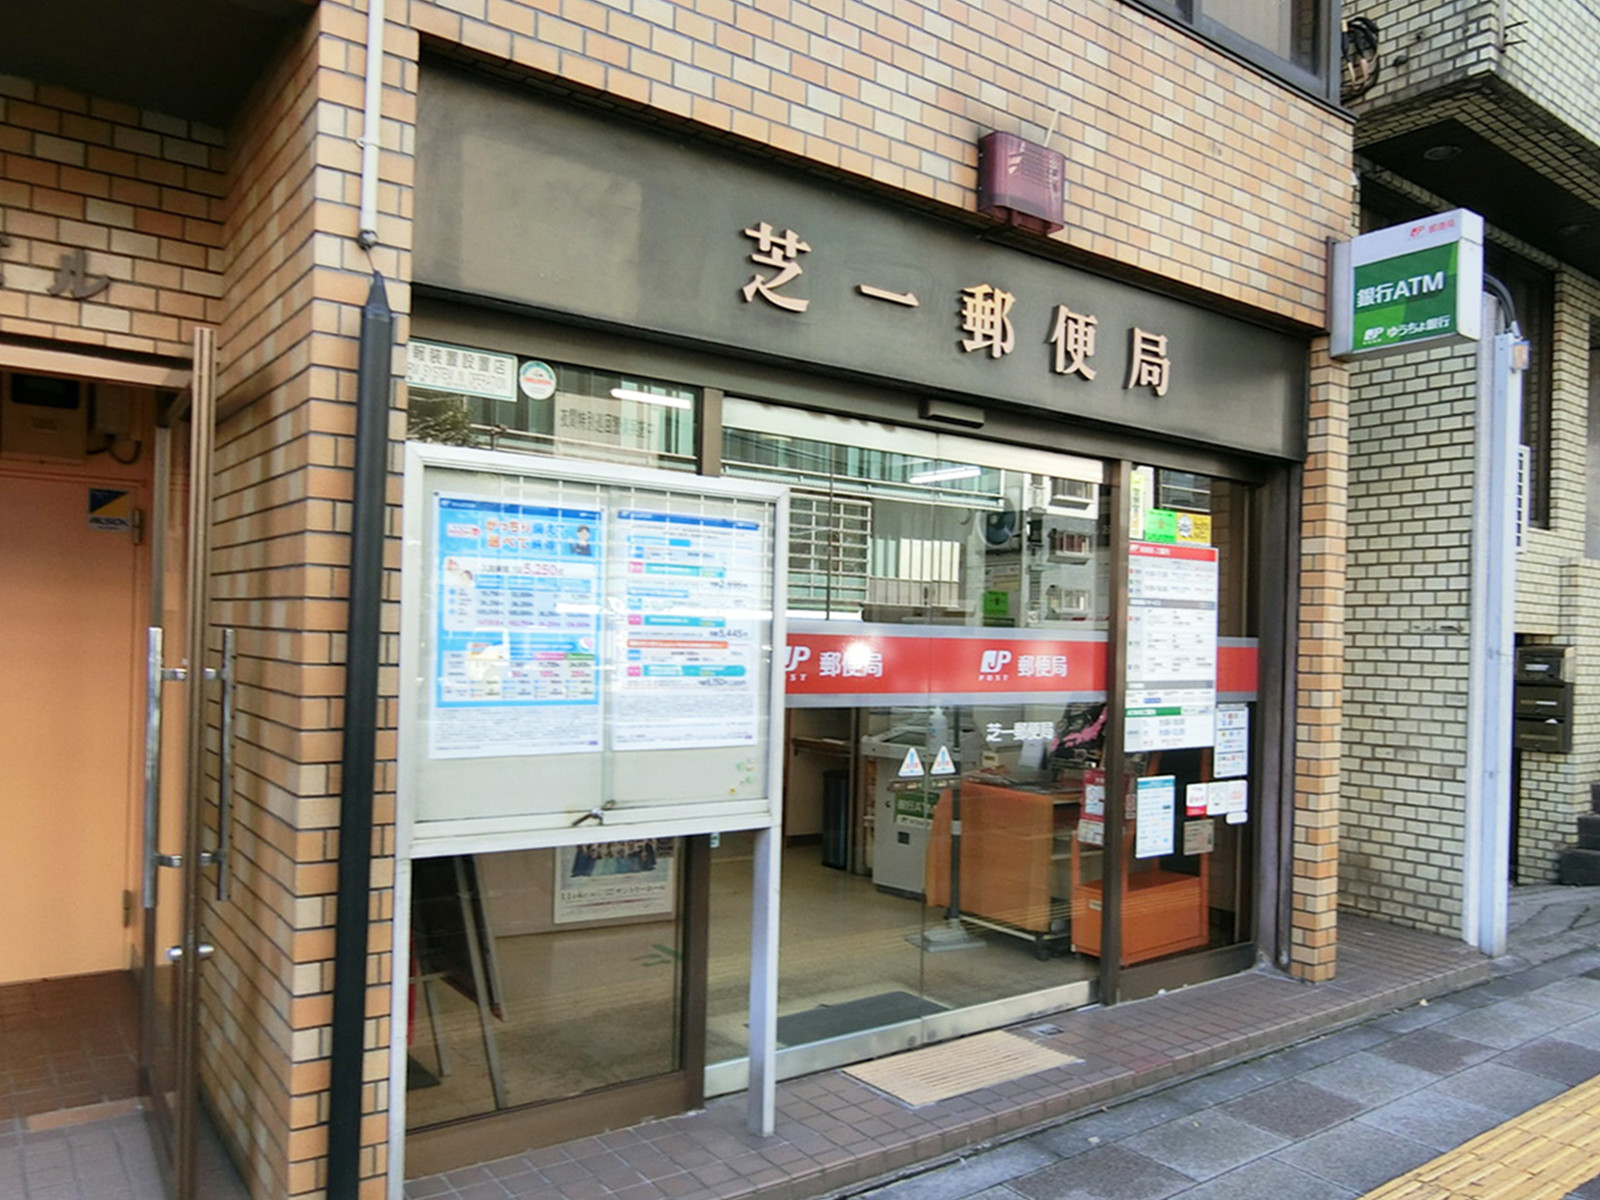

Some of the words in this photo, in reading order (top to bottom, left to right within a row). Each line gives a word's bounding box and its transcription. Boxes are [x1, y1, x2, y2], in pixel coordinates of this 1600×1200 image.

[1356, 271, 1445, 308] 銀行ATM
[742, 222, 1171, 397] 芝一郵便局
[1386, 315, 1451, 338] ゆうちょ銀行
[1017, 655, 1068, 677] 郵便局
[986, 722, 1055, 743] 芝一郵便局
